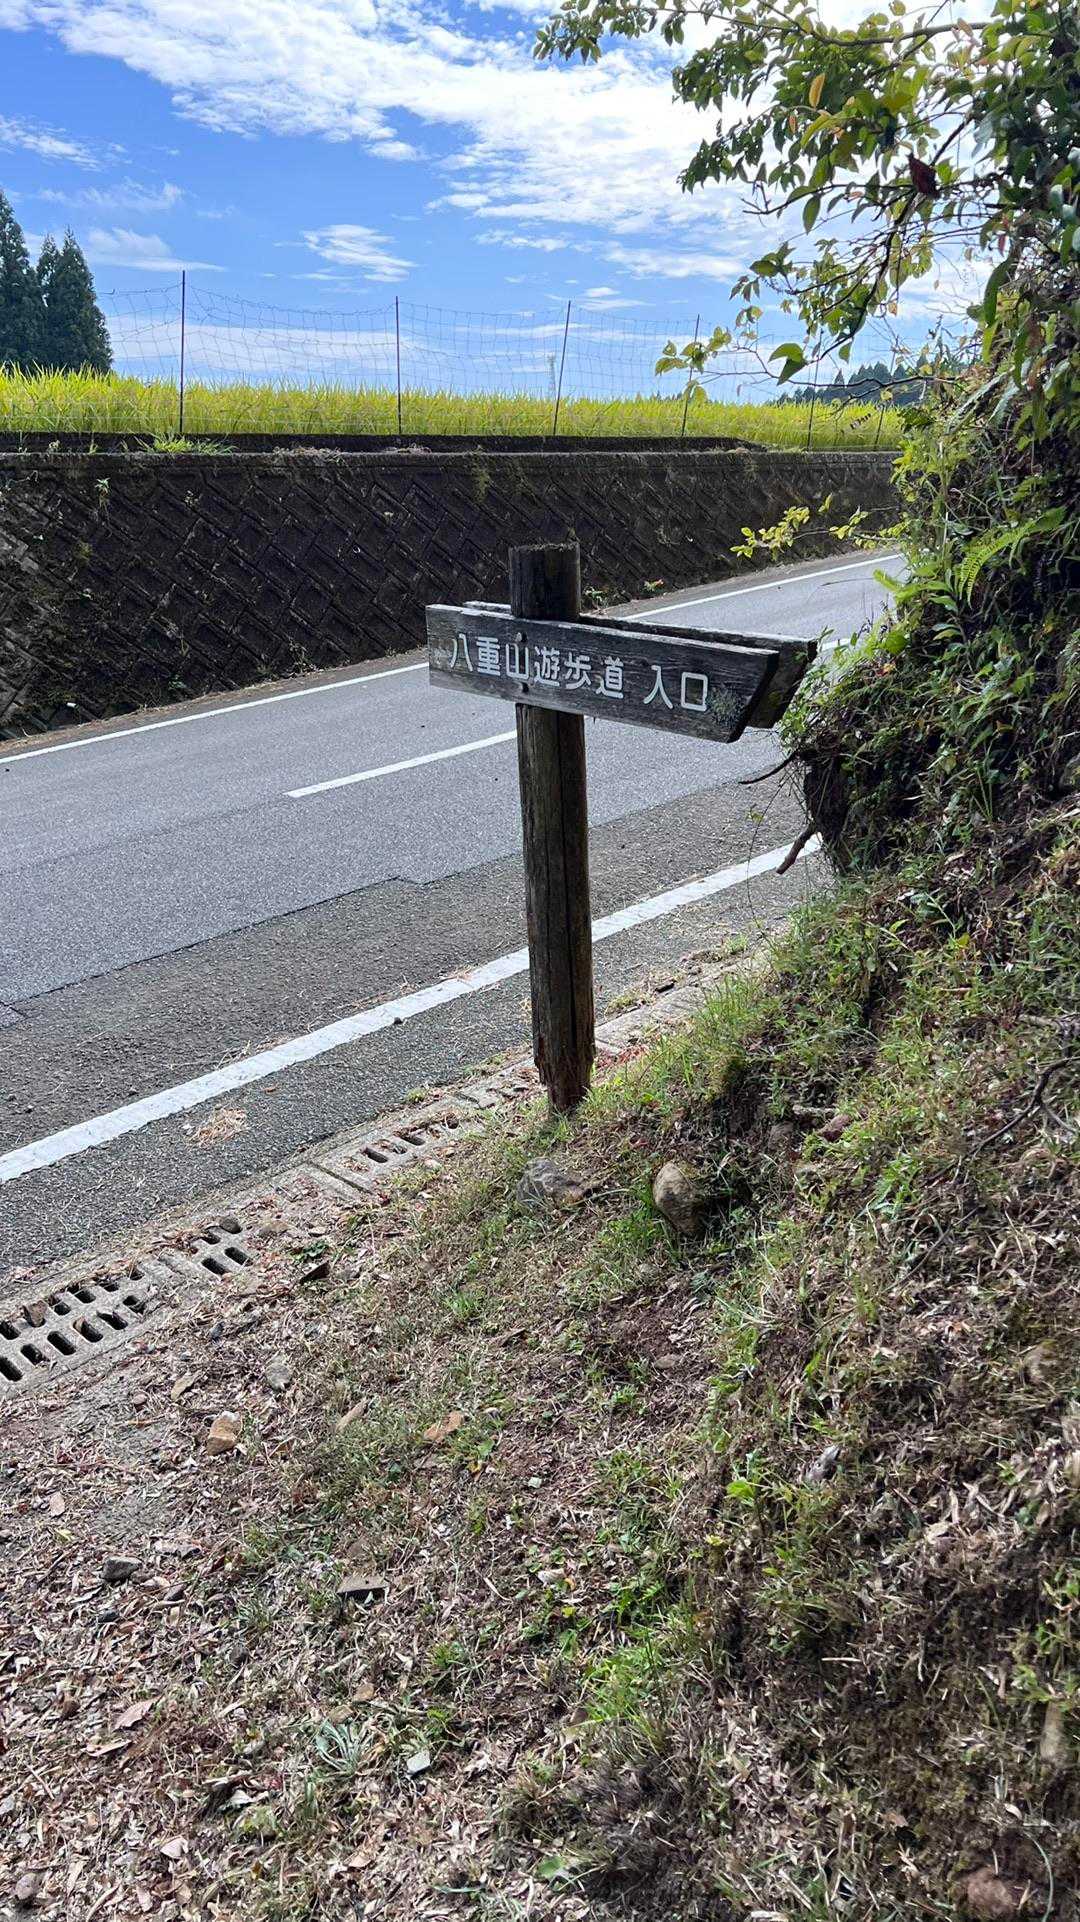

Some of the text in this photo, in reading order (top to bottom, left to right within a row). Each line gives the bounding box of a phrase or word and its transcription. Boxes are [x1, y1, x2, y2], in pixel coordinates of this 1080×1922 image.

[449, 632, 709, 712] 八重山遊歩道 入口
